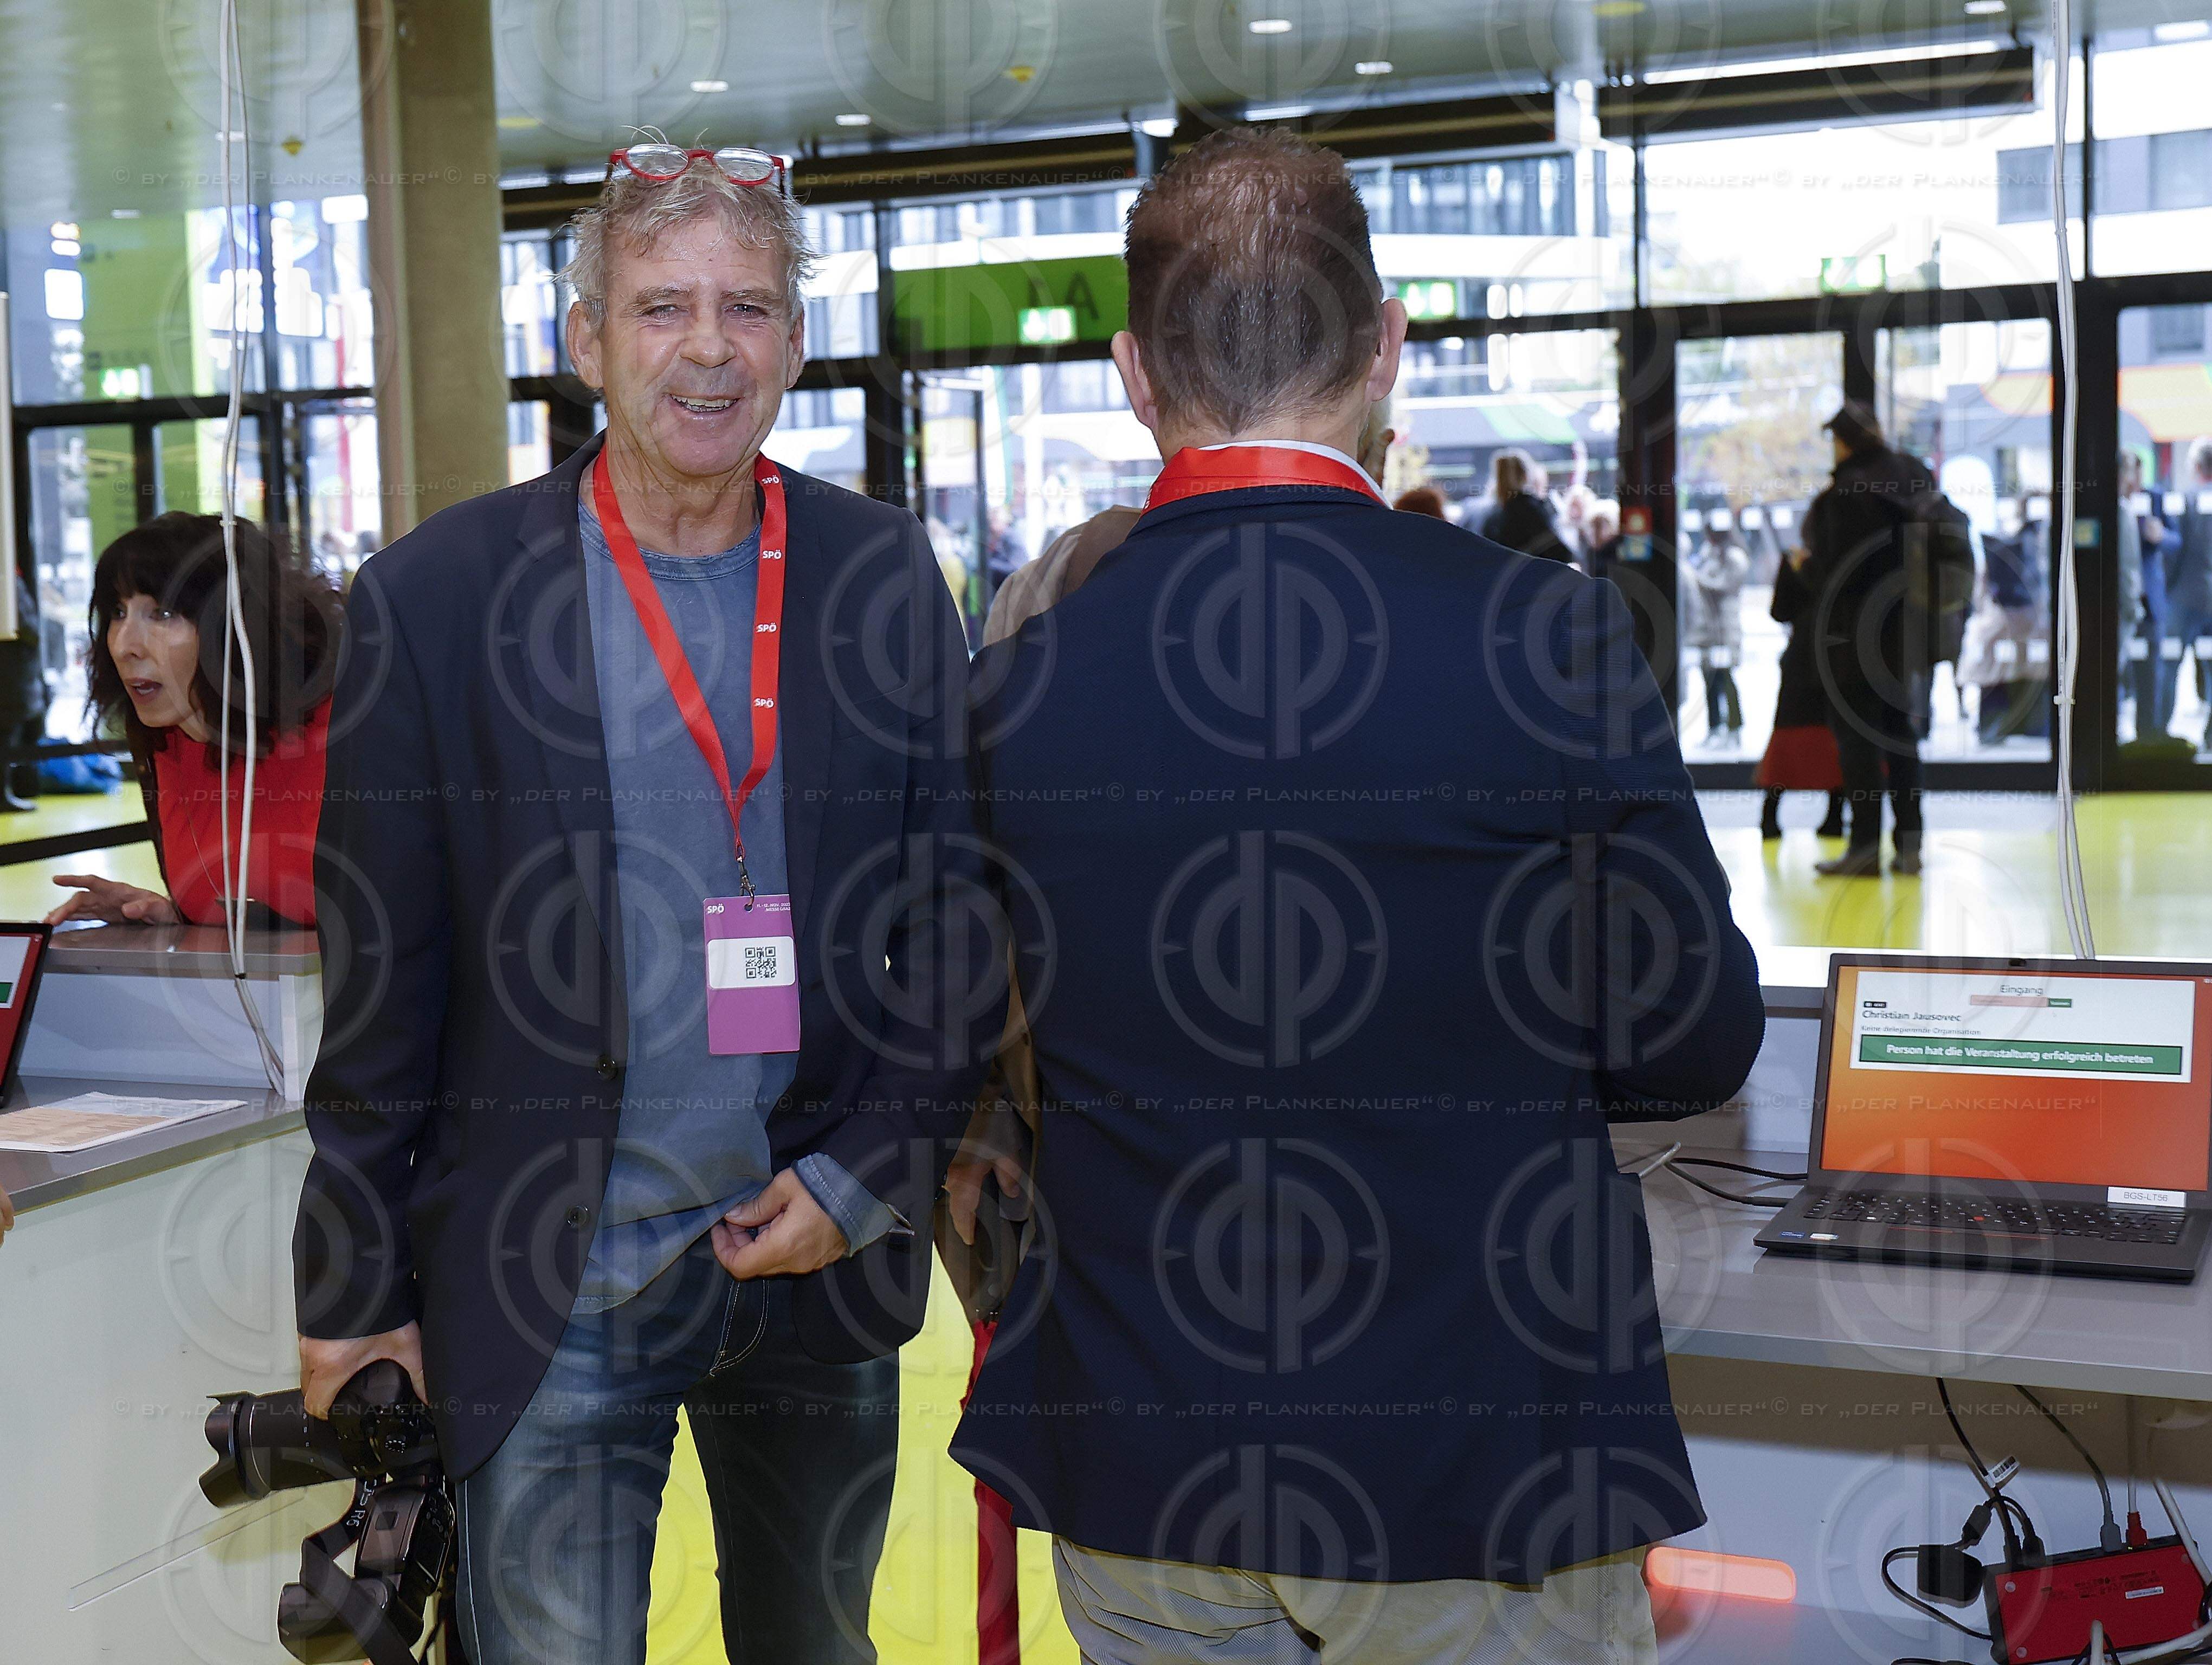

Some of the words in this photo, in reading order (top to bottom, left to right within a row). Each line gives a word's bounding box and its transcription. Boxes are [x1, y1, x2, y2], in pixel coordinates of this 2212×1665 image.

[761, 475, 779, 485] SPÖ
[763, 549, 782, 560] SPÖ
[756, 623, 776, 633] SPÖ
[753, 698, 774, 708] SPÖ
[707, 904, 725, 914] SPÖ
[2000, 984, 2043, 996] Eingang
[1862, 1010, 1910, 1019] Christian
[1886, 1044, 1923, 1056] Person
[1925, 1045, 1943, 1057] hat
[1945, 1046, 1963, 1058] die
[1964, 1047, 2040, 1062] Veranstaltung
[2042, 1049, 2103, 1063] erfolgreich
[2105, 1053, 2153, 1064] betreten
[2123, 1192, 2168, 1202] BGS-LT56
